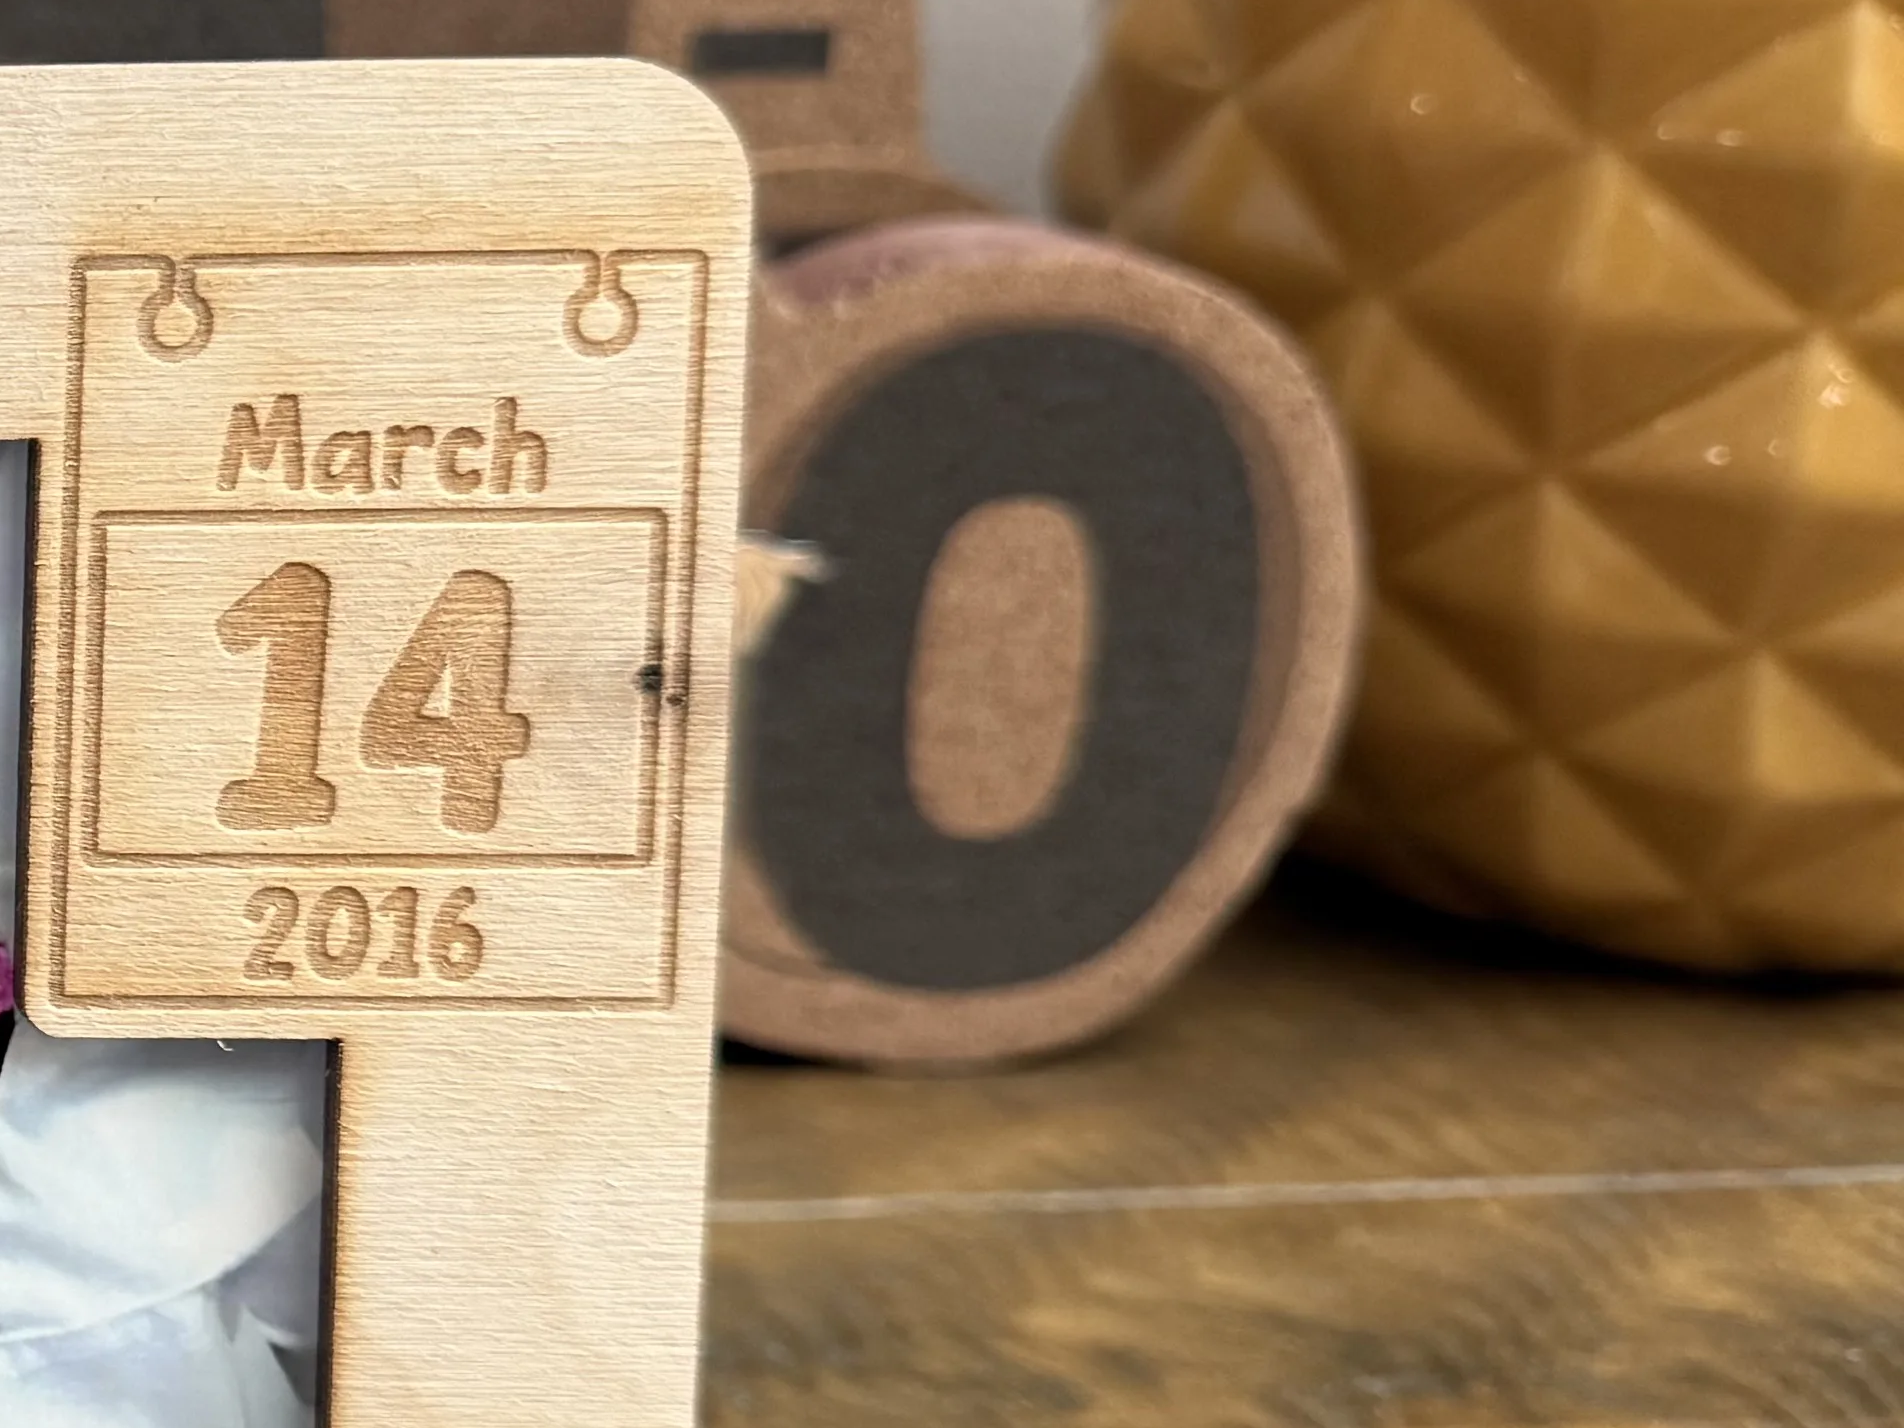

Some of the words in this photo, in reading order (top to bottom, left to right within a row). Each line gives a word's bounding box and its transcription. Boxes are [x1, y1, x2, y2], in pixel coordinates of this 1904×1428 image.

[217, 393, 548, 494] March
[215, 561, 532, 832] 14
[241, 885, 485, 979] 2016
